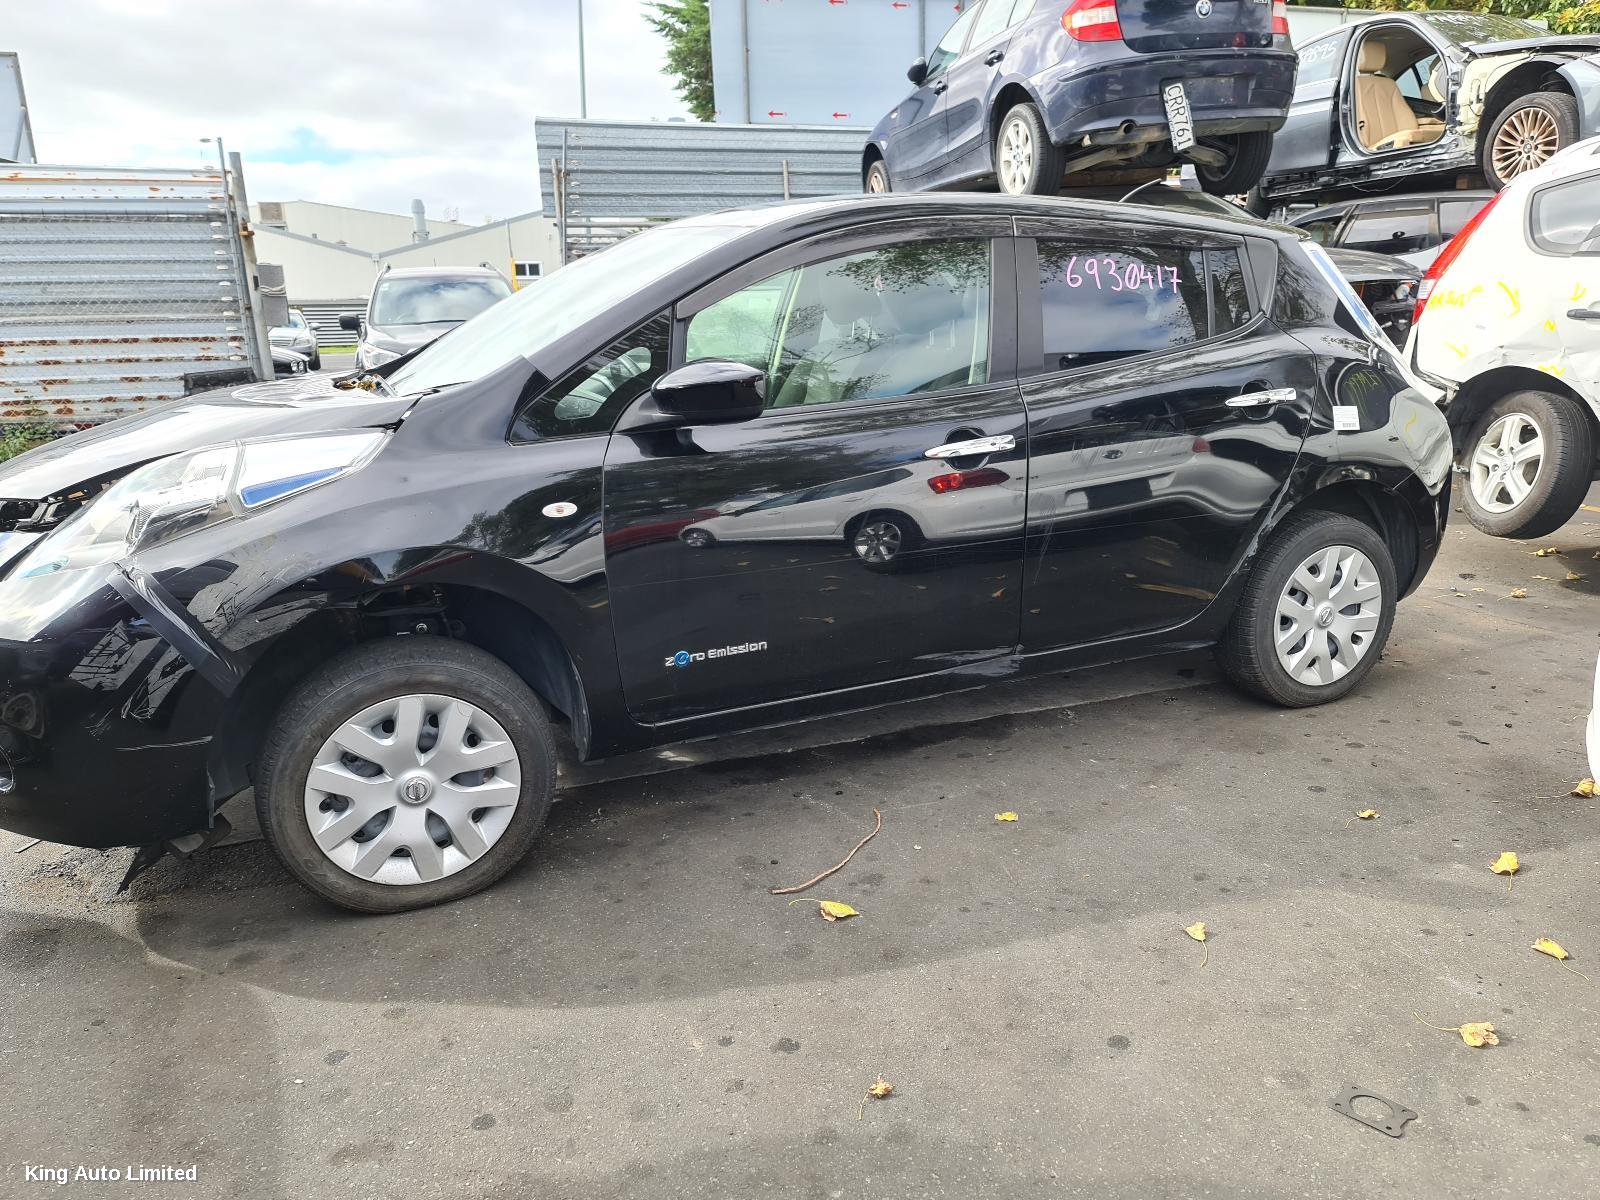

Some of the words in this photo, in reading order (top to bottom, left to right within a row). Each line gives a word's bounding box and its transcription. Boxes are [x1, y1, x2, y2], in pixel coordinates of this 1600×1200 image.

[1168, 85, 1192, 147] CRR761
[1066, 256, 1183, 294] 6930417
[707, 641, 768, 659] Emission
